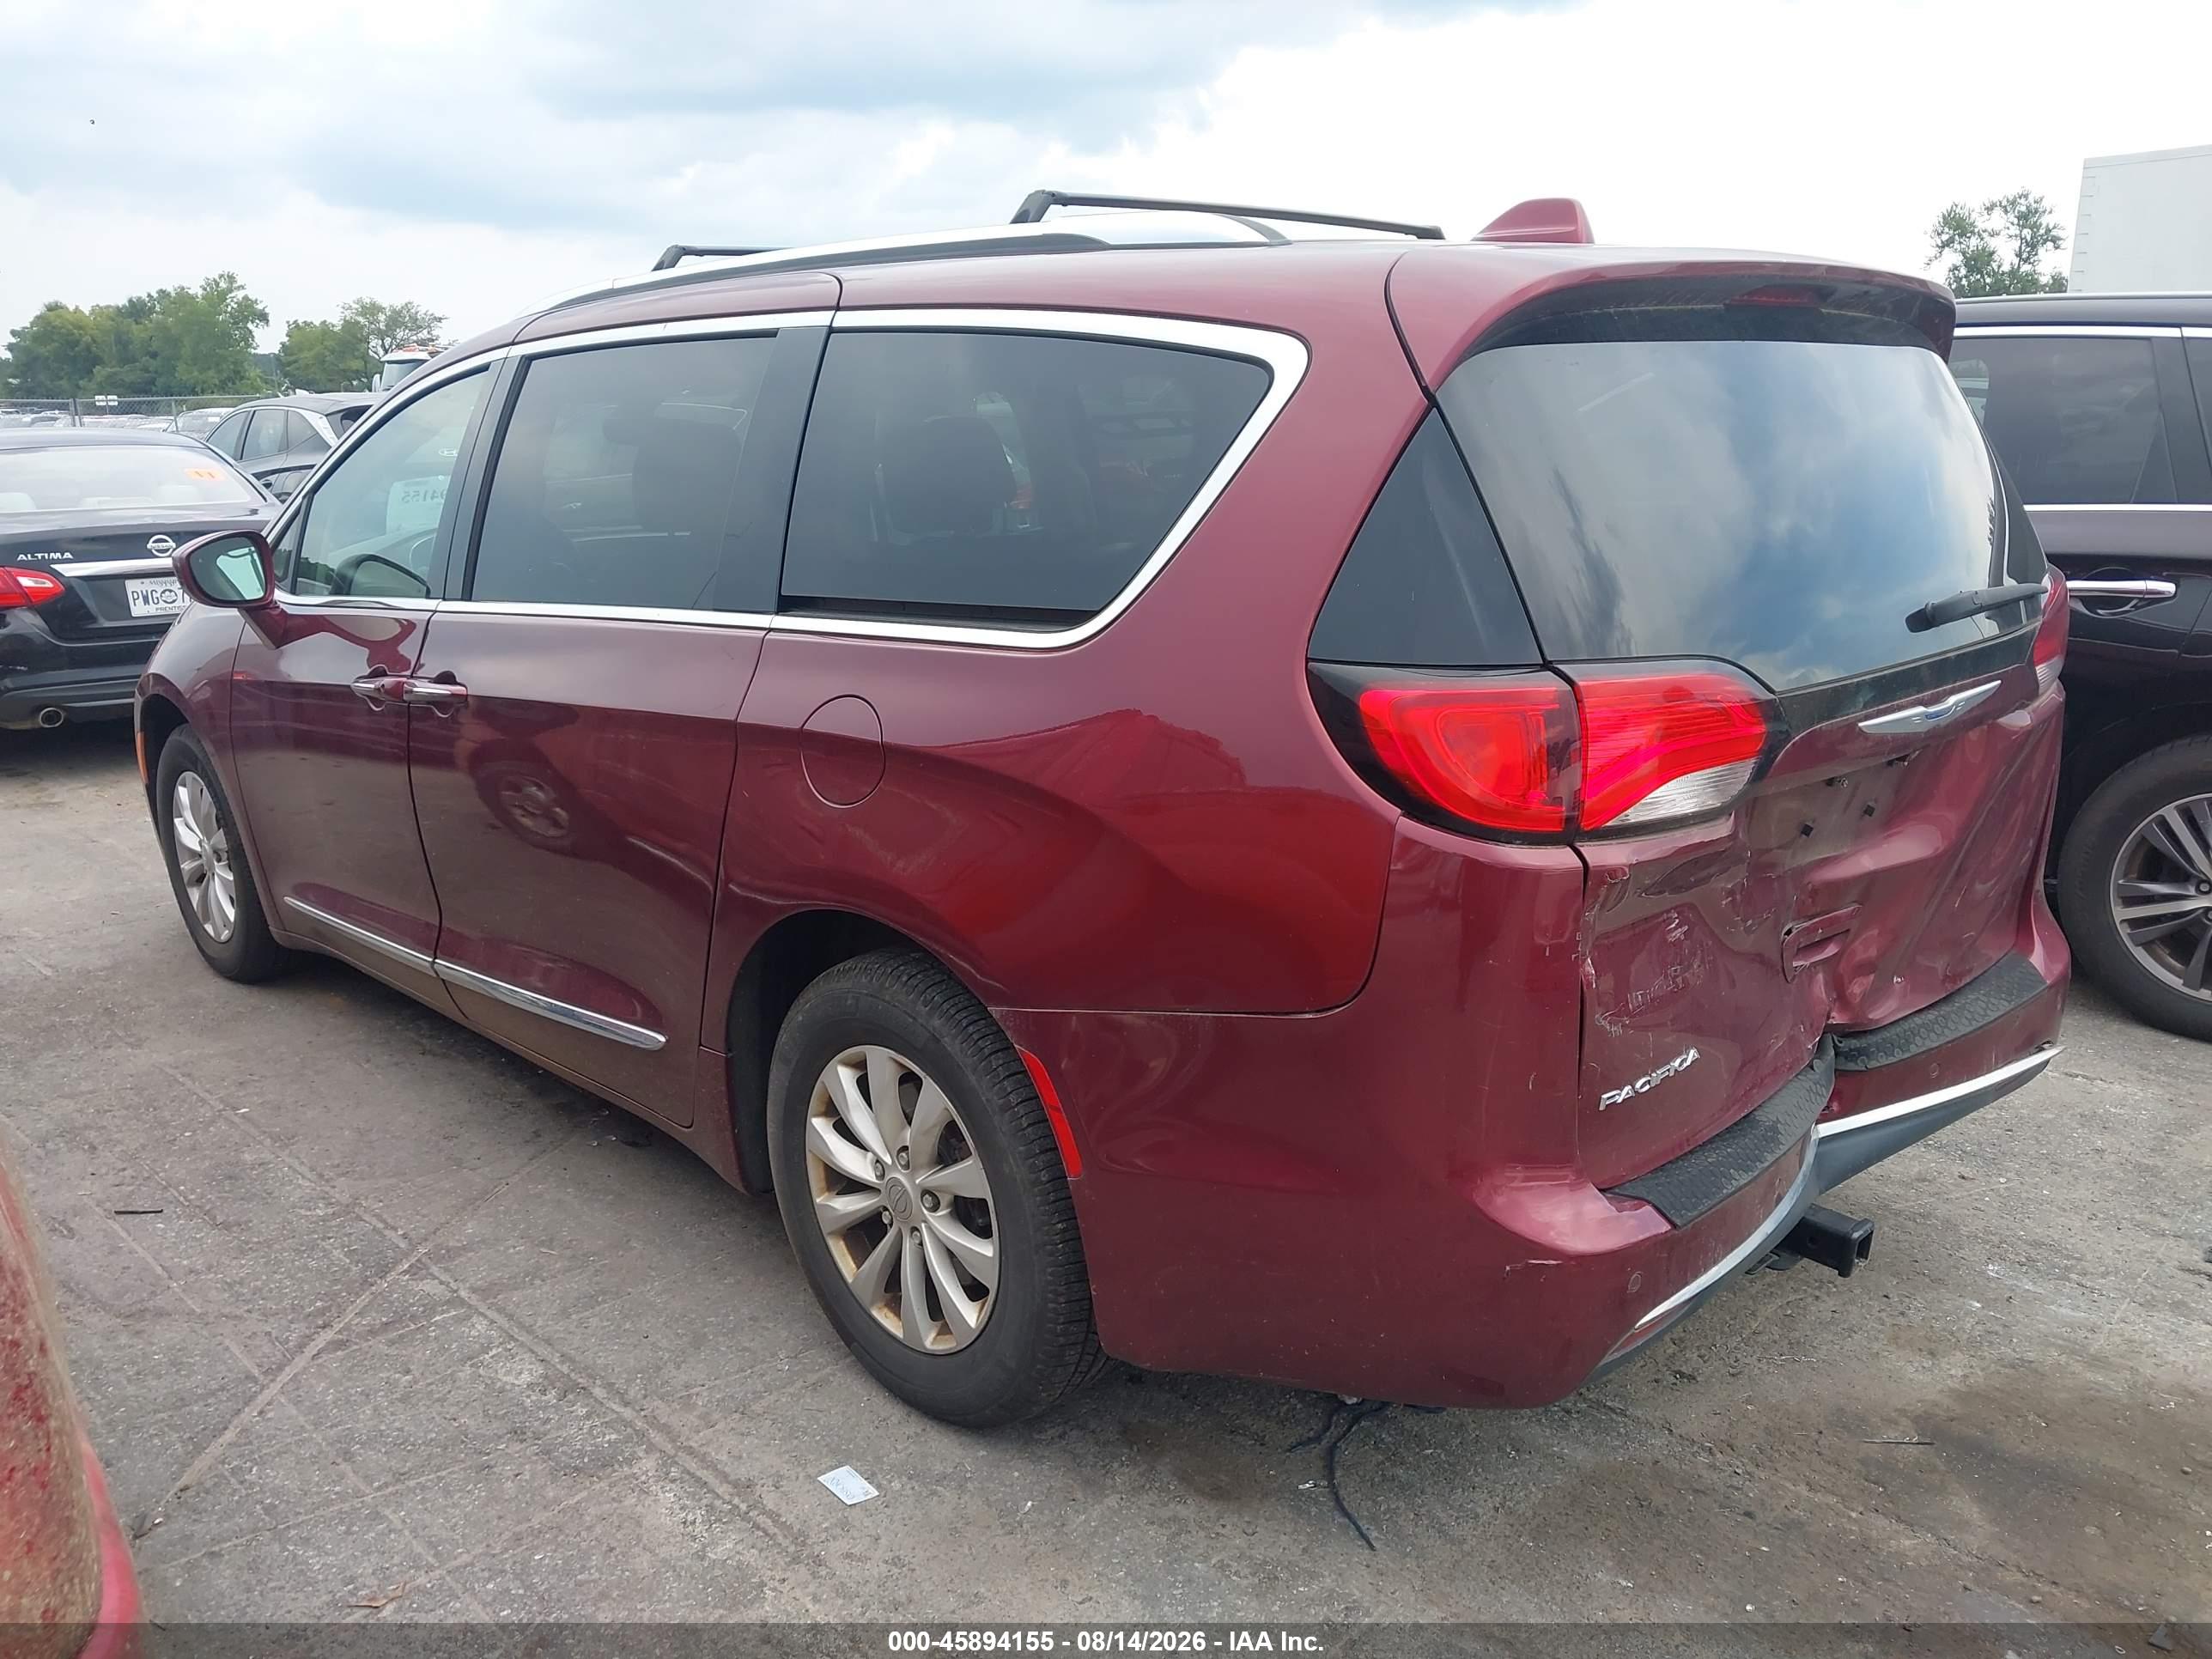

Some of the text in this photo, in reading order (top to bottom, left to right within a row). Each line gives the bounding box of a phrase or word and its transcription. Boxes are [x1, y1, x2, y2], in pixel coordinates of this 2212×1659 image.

[16, 552, 75, 562] ALTIMA
[131, 589, 160, 606] PWG
[1599, 1046, 1701, 1111] PACIFICA
